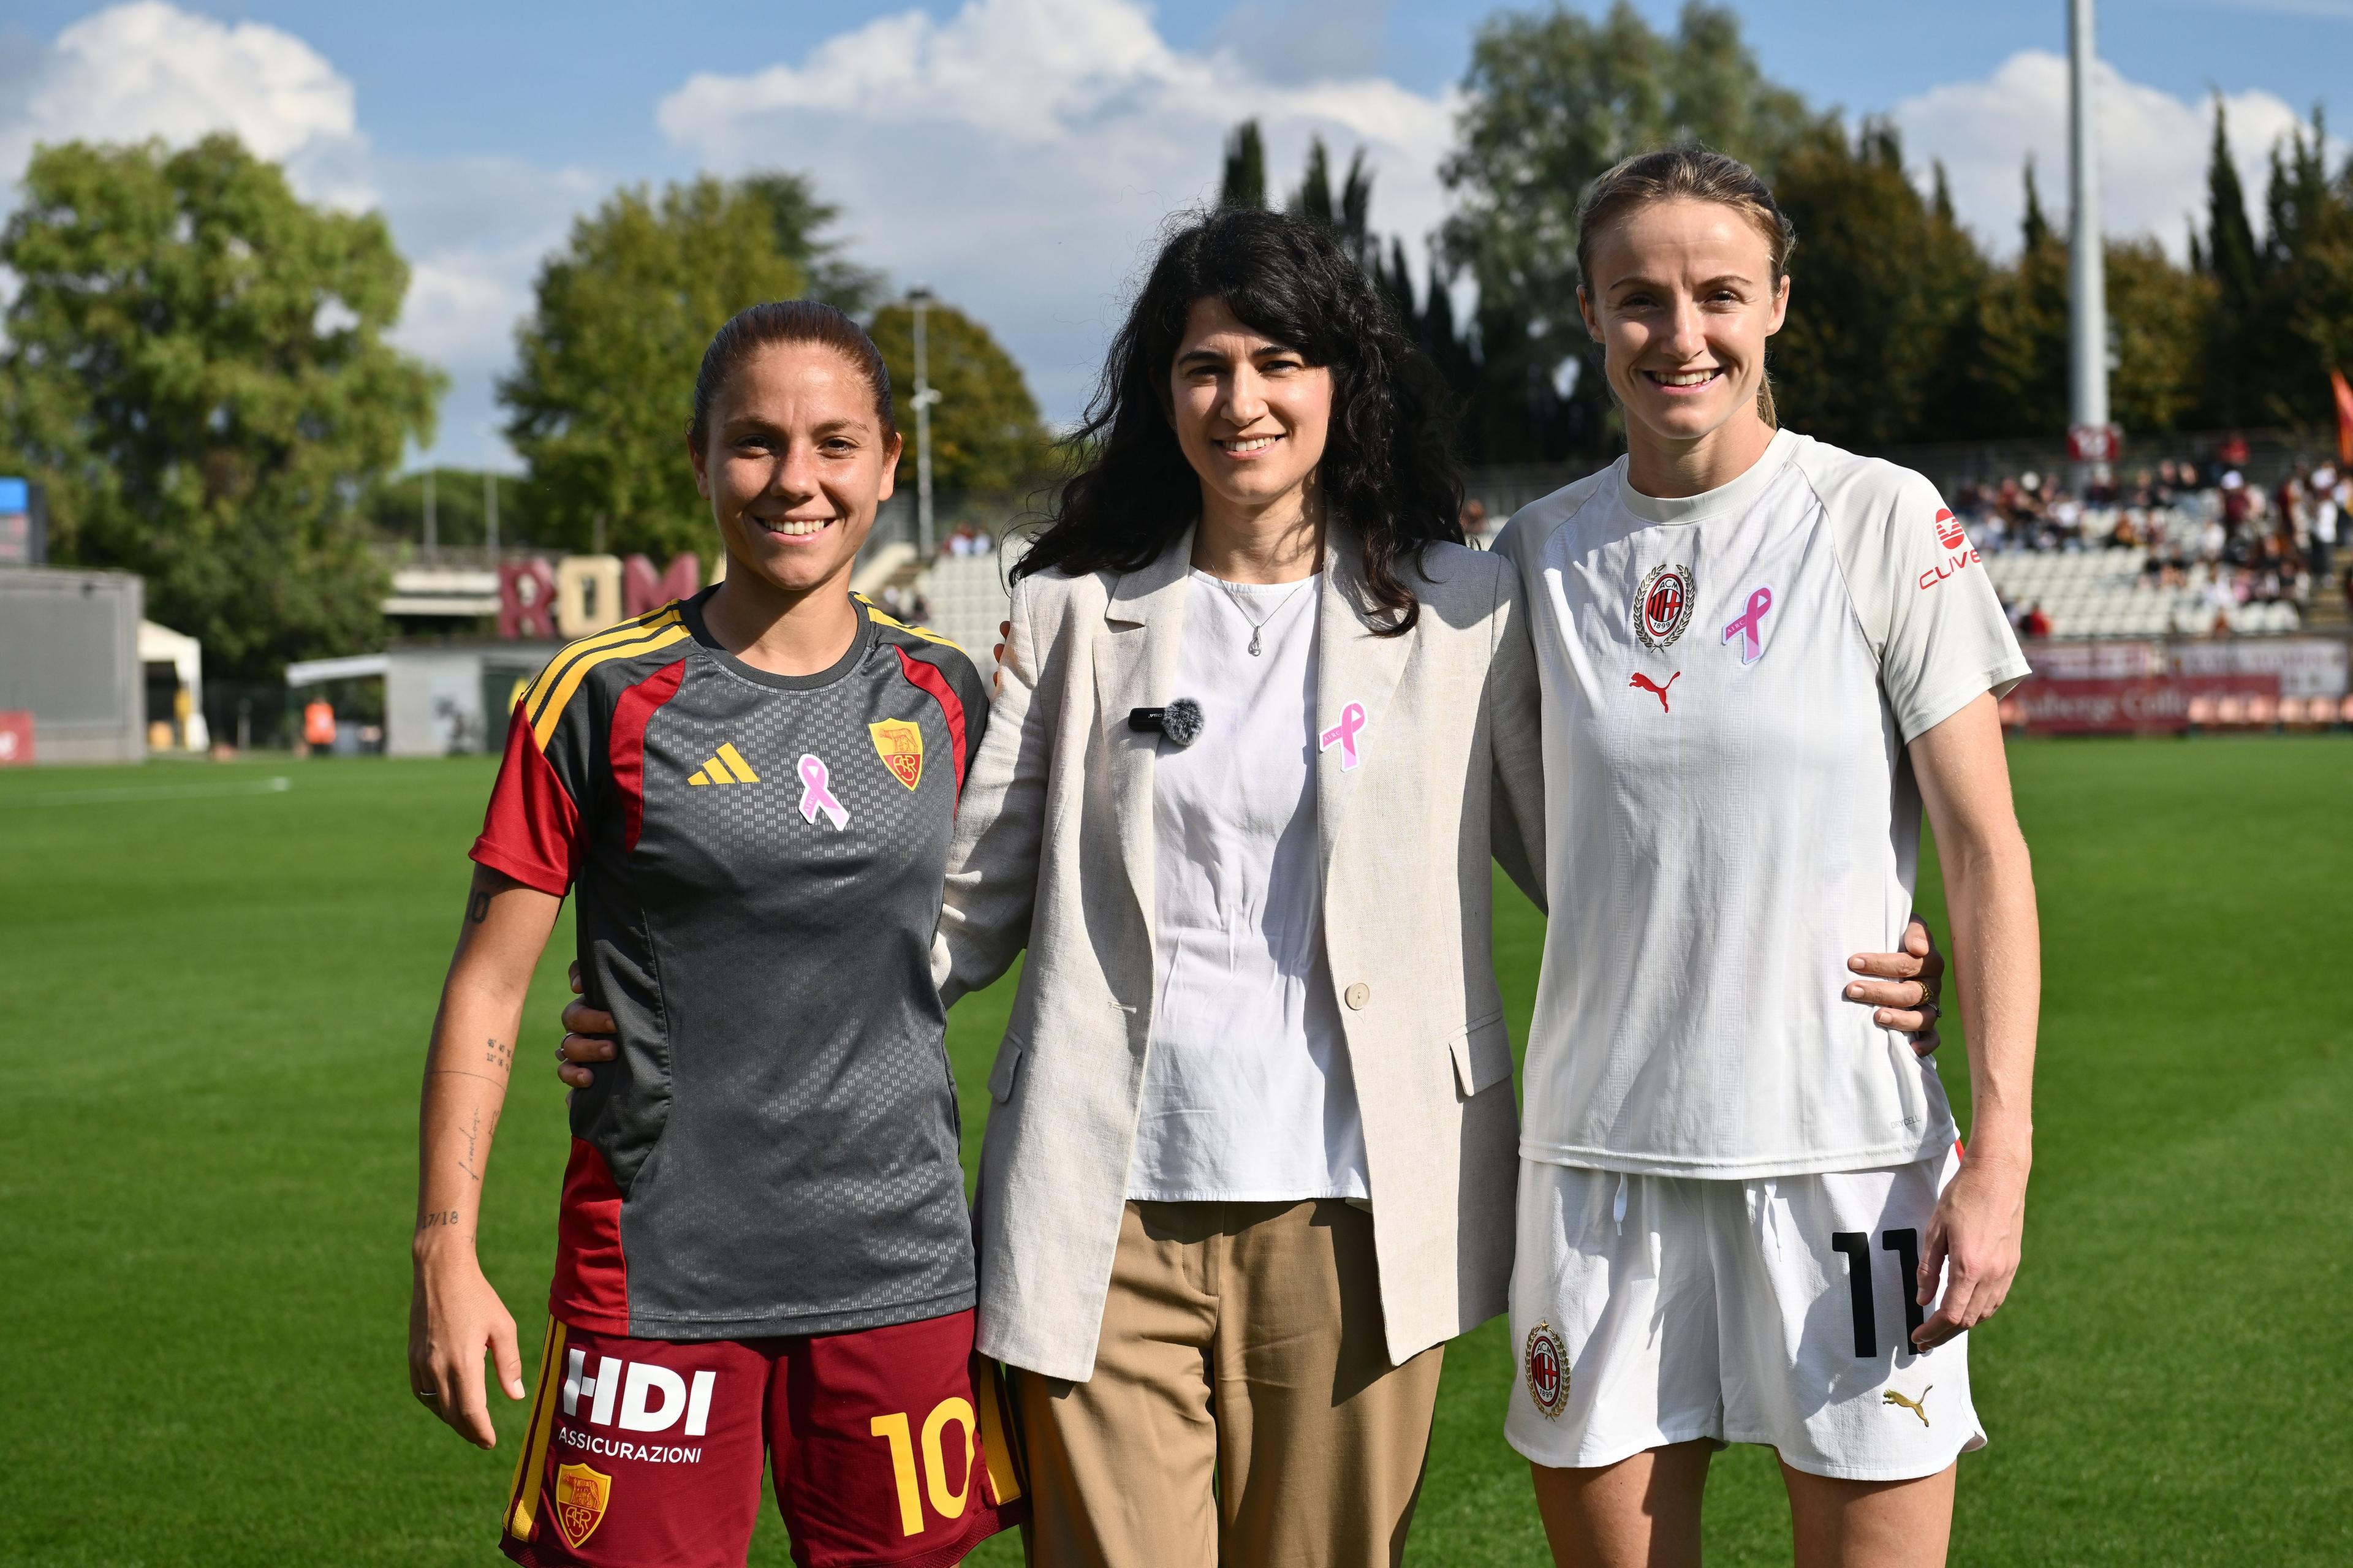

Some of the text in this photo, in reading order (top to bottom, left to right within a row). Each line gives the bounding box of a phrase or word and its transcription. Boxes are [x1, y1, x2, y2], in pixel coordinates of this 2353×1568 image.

[1658, 578, 1678, 591] ACM
[498, 554, 727, 640] ROM
[1727, 619, 1745, 634] AIRC
[1324, 730, 1341, 741] AIRC
[1891, 1115, 1922, 1129] DRYCELL
[422, 1211, 458, 1229] 17/18
[1832, 1228, 1927, 1358] 11
[1536, 1343, 1553, 1357] ACM
[563, 1348, 717, 1436] HDI
[1539, 1388, 1553, 1398] 1899
[558, 1426, 702, 1463] ASSICURAZIONI
[870, 1396, 976, 1537] 10
